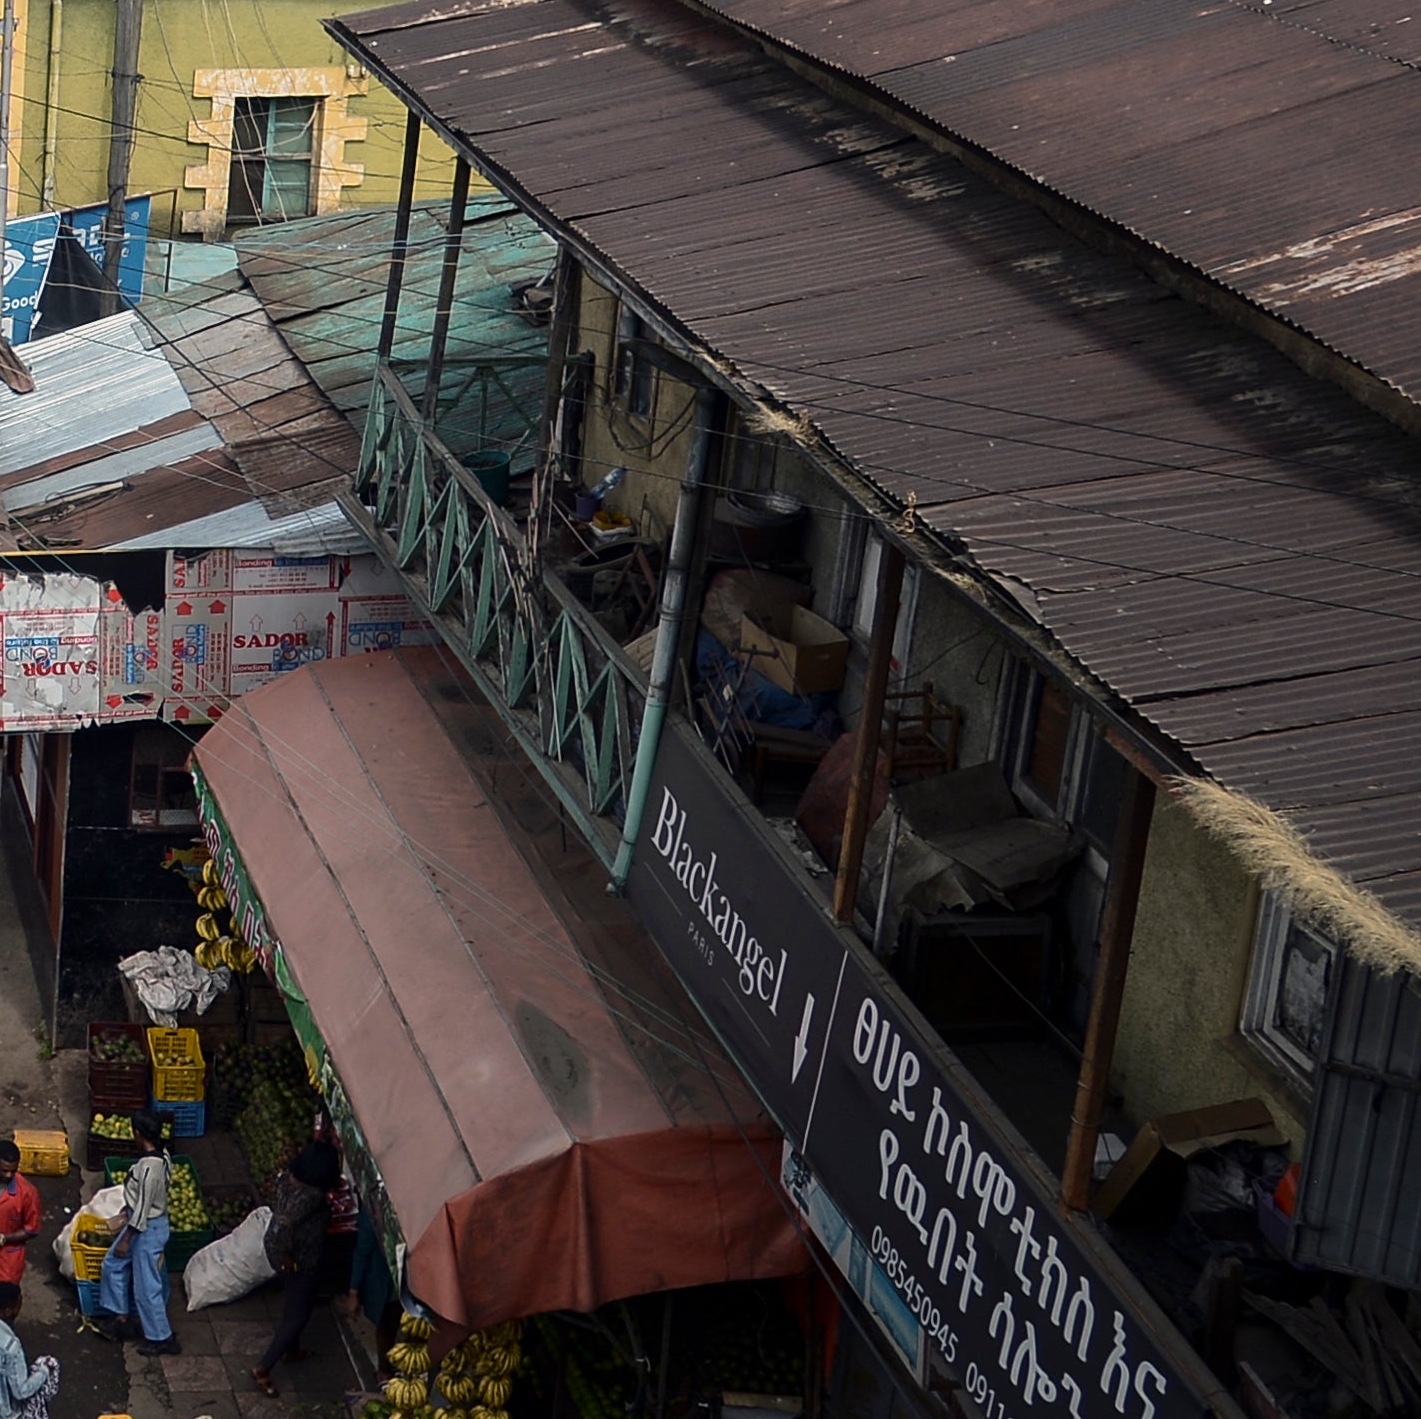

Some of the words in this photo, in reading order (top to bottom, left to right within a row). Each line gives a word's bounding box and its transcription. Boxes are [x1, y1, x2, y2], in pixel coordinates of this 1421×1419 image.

[233, 632, 309, 648] SADOR
[349, 631, 401, 646] BOND
[5, 646, 58, 662] BOND
[272, 646, 325, 662] BOND
[22, 660, 98, 677] SADOR
[171, 637, 184, 693] SADOR
[232, 664, 269, 672] Bonding
[651, 785, 788, 1016] Blackangel
[687, 921, 714, 966] PARIS
[878, 1128, 984, 1313] የውበት
[871, 1224, 959, 1364] 0985450945
[965, 1362, 1015, 1419] 0911
